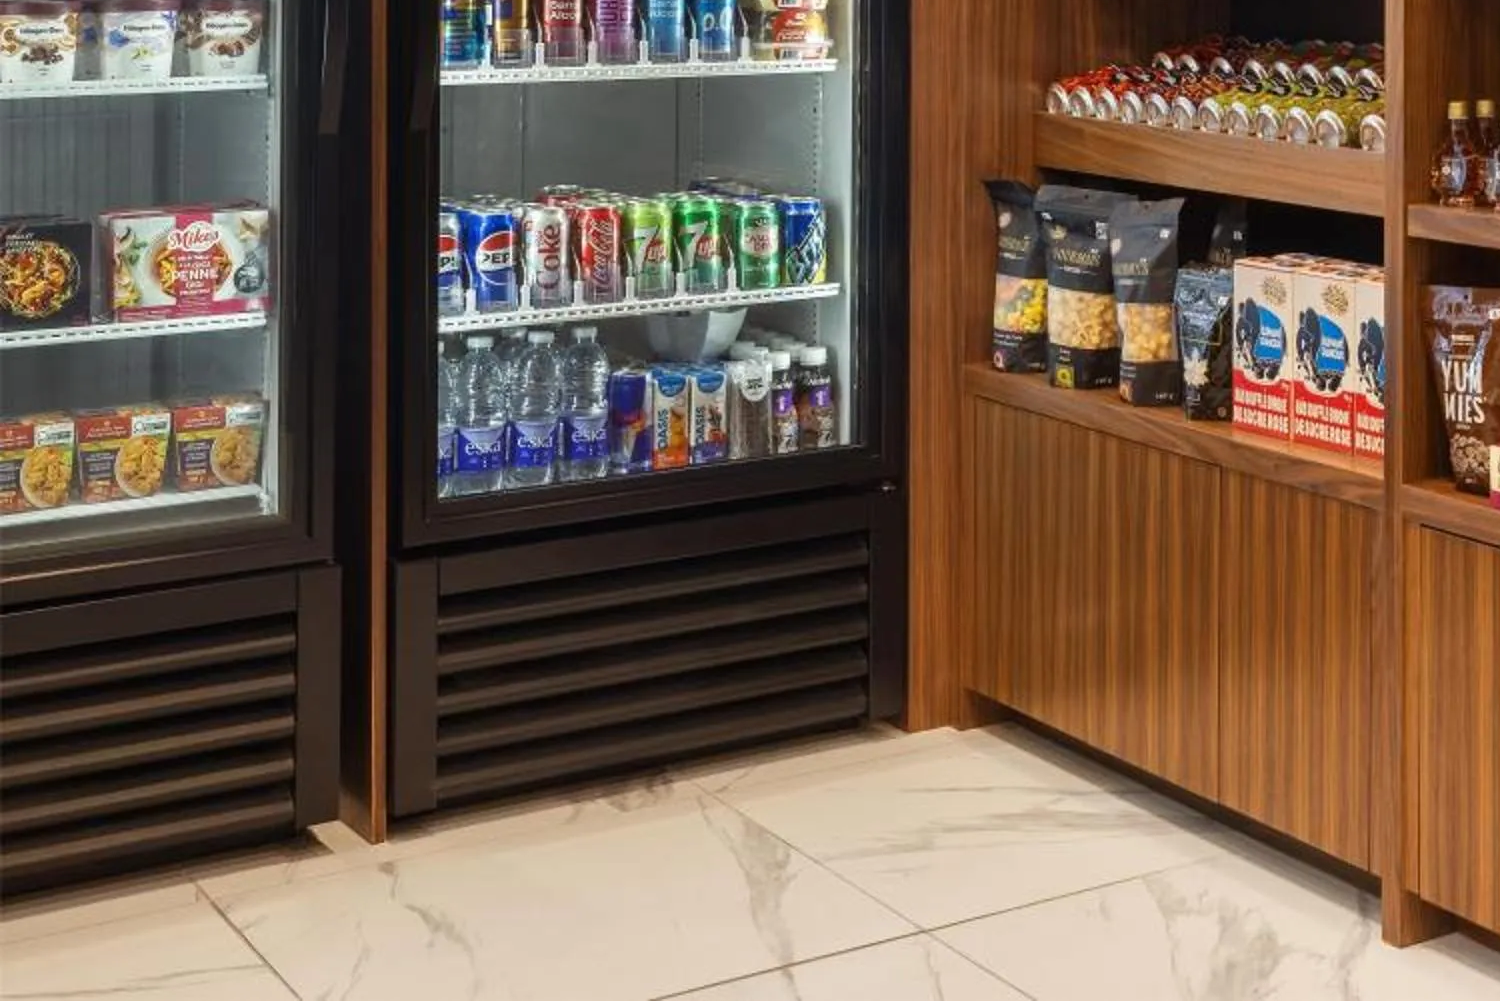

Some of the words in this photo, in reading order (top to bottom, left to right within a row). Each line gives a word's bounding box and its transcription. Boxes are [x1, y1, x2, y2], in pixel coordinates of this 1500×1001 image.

[535, 224, 561, 290] Coke
[1441, 360, 1483, 394] YUM
[571, 429, 607, 443] eska
[657, 408, 669, 449] OASIS
[464, 440, 501, 456] eska
[517, 435, 554, 449] eska
